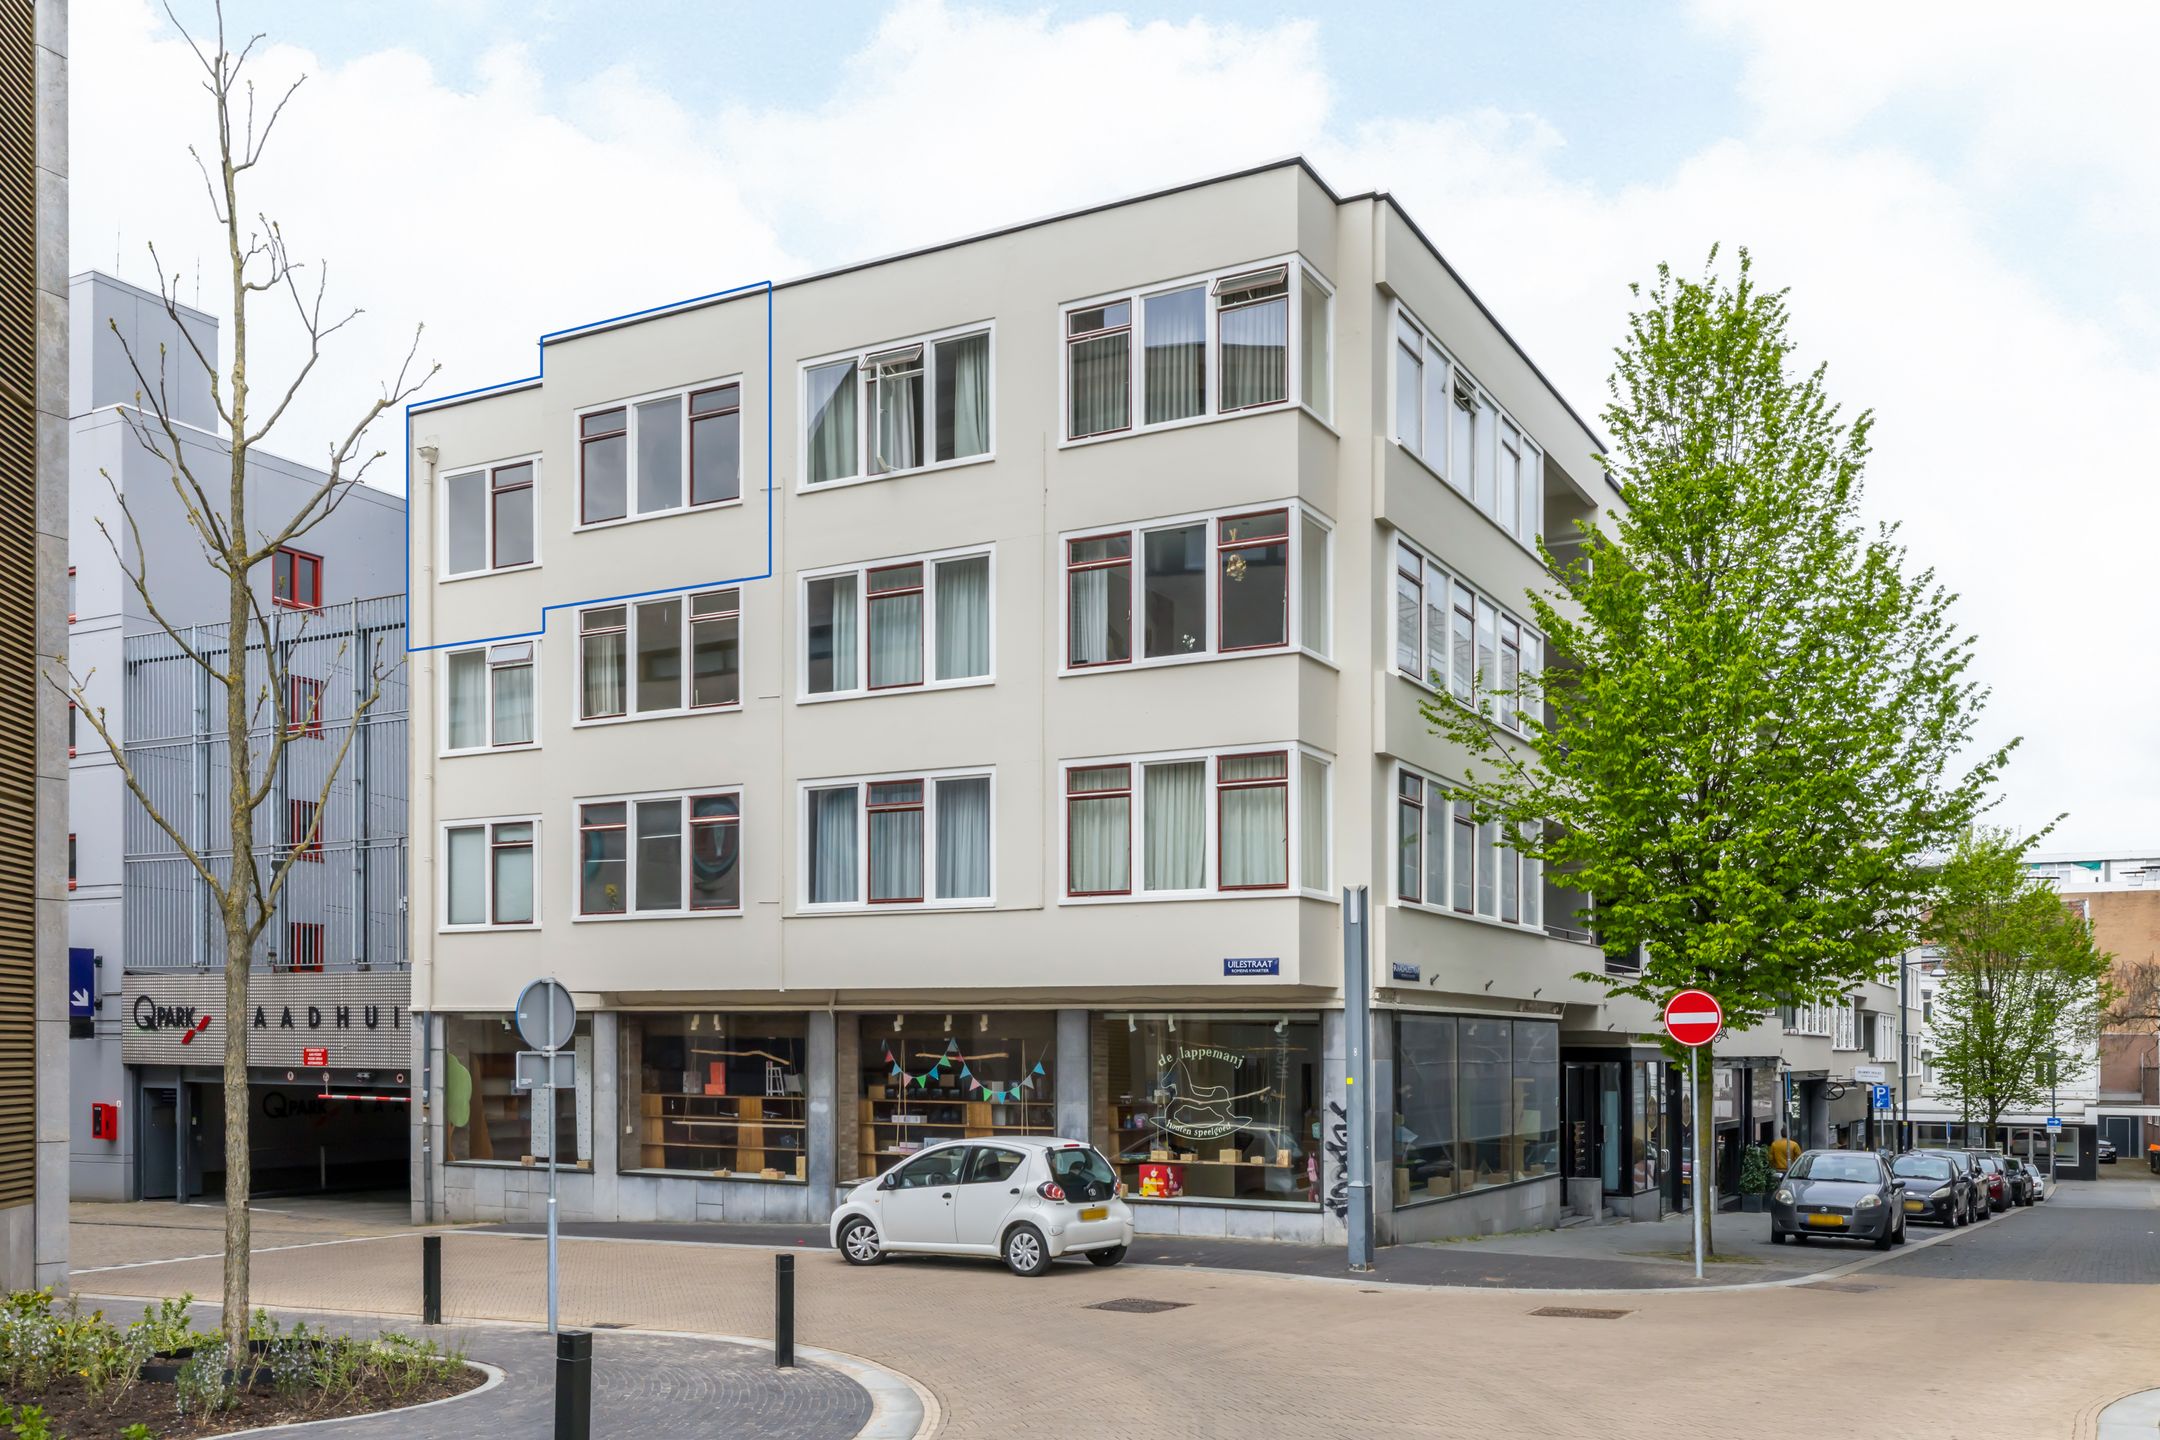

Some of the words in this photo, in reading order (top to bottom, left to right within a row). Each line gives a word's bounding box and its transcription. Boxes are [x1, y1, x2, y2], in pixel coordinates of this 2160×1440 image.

[1227, 960, 1273, 969] UILESTRAAT
[254, 1006, 399, 1029] AADHUI
[1158, 1053, 1173, 1067] de
[1179, 1046, 1245, 1070] lappemanj
[1353, 1047, 1358, 1056] 8
[1876, 1087, 1886, 1099] P
[1166, 1119, 1192, 1135] houten
[1193, 1122, 1231, 1138] speelgoed
